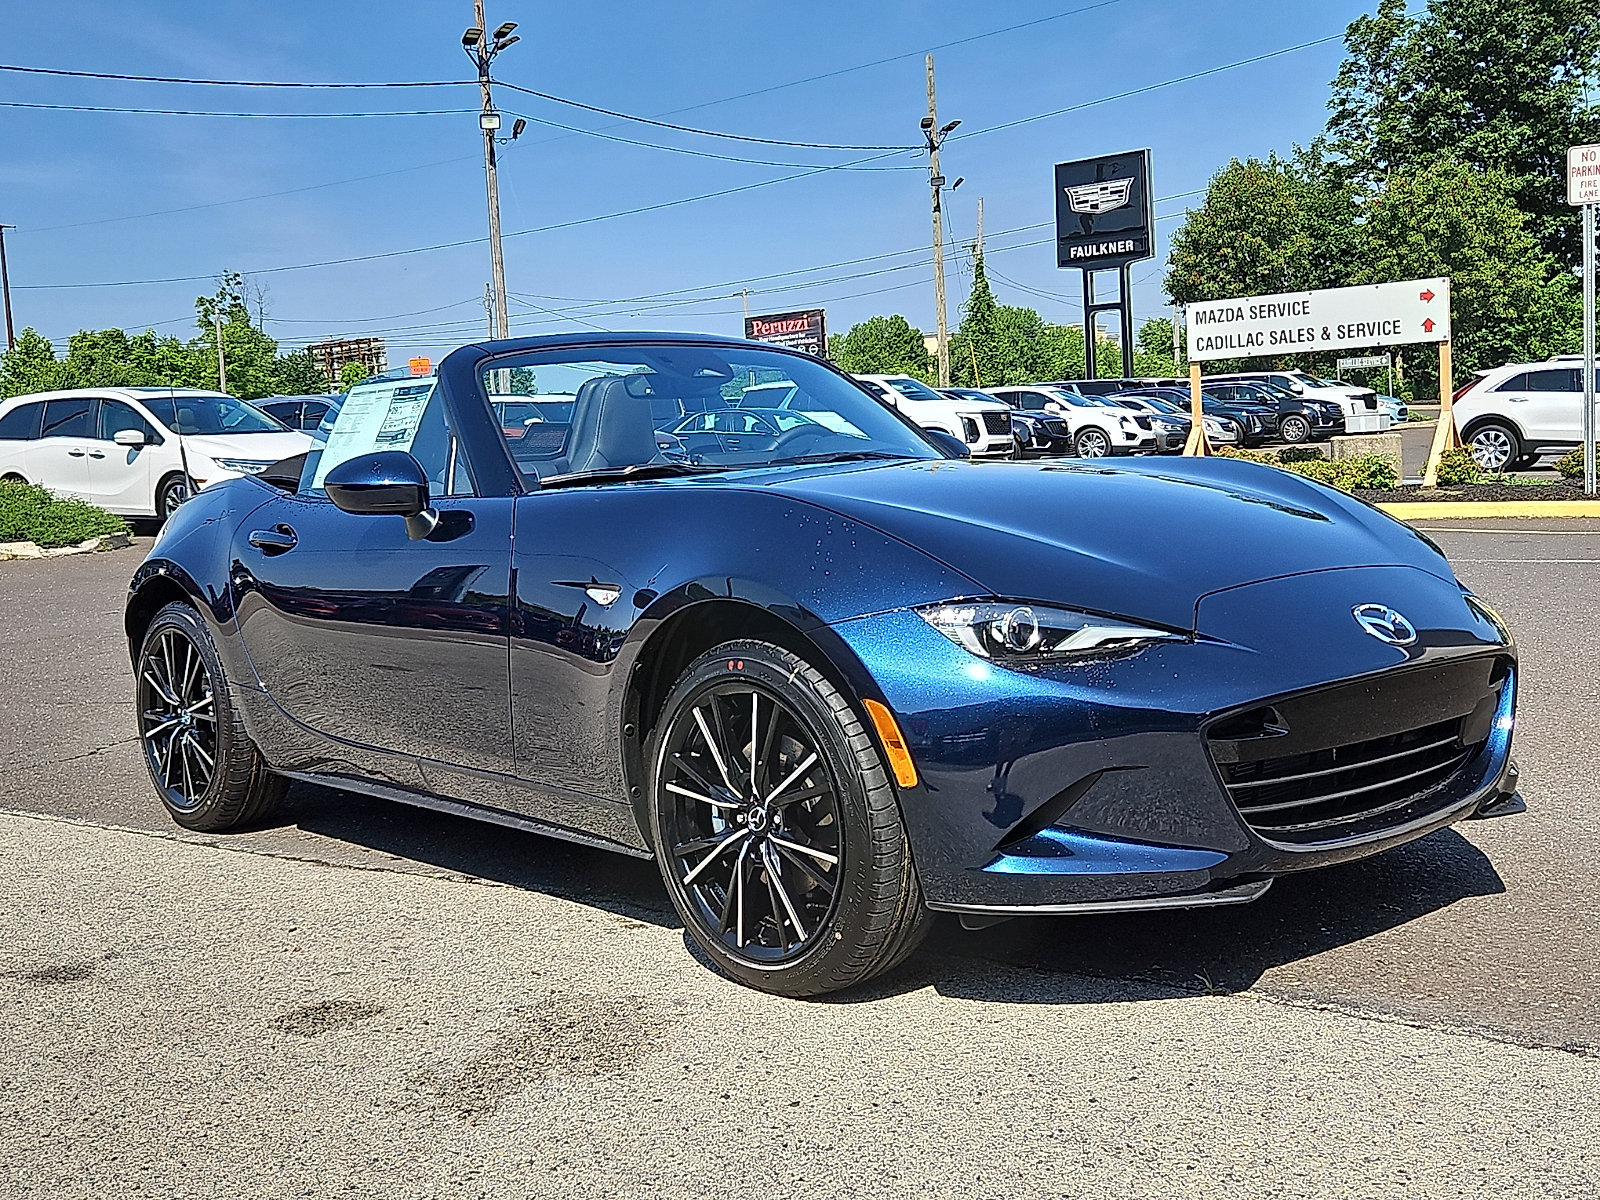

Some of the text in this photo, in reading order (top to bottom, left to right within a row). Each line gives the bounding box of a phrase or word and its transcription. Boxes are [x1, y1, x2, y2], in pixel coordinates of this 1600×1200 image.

[1582, 151, 1596, 162] NO
[1572, 165, 1600, 177] PARKIN
[1581, 180, 1597, 188] FIRE
[1579, 190, 1598, 198] LANE
[1070, 240, 1134, 259] FAULKNER
[1195, 300, 1311, 326] MAZDA SERVICE
[752, 314, 809, 336] Peruzzi
[1196, 319, 1402, 352] CADILLAC SALES & SERVICE
